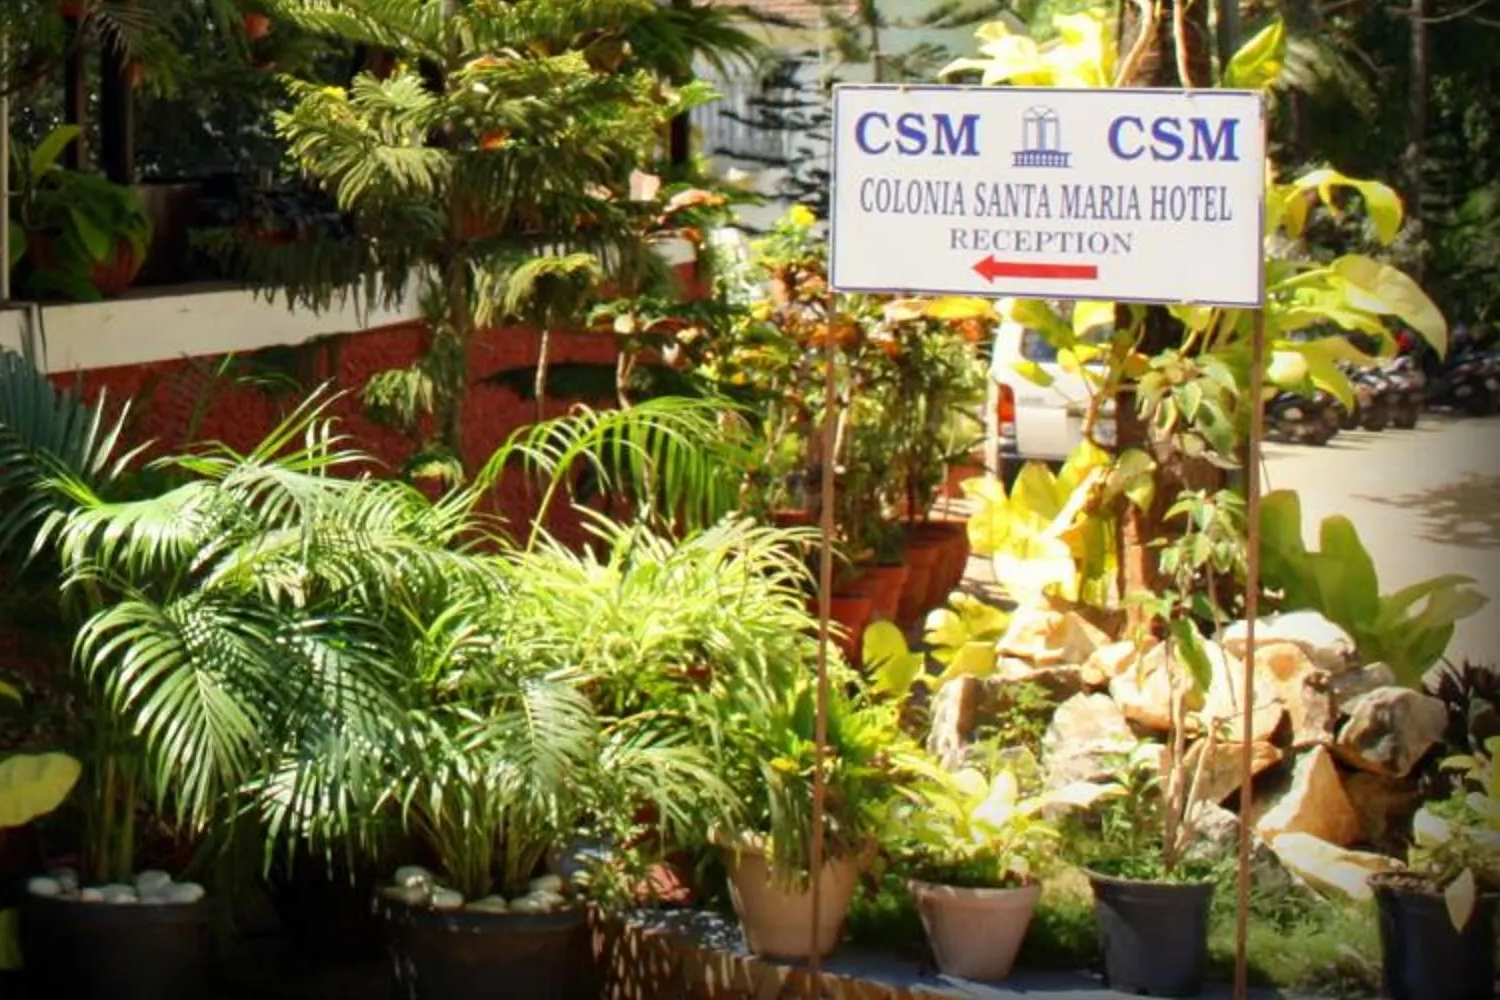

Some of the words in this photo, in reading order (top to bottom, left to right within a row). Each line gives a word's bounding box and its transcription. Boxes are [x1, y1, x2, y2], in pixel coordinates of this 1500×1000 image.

[854, 111, 981, 157] CSM
[1107, 116, 1241, 162] CSM
[859, 177, 967, 217] COLONIA
[973, 181, 1052, 219] SANTA
[1060, 184, 1142, 221] MARIA
[1150, 186, 1233, 222] HOTEL
[949, 227, 1133, 255] RECEPTION
